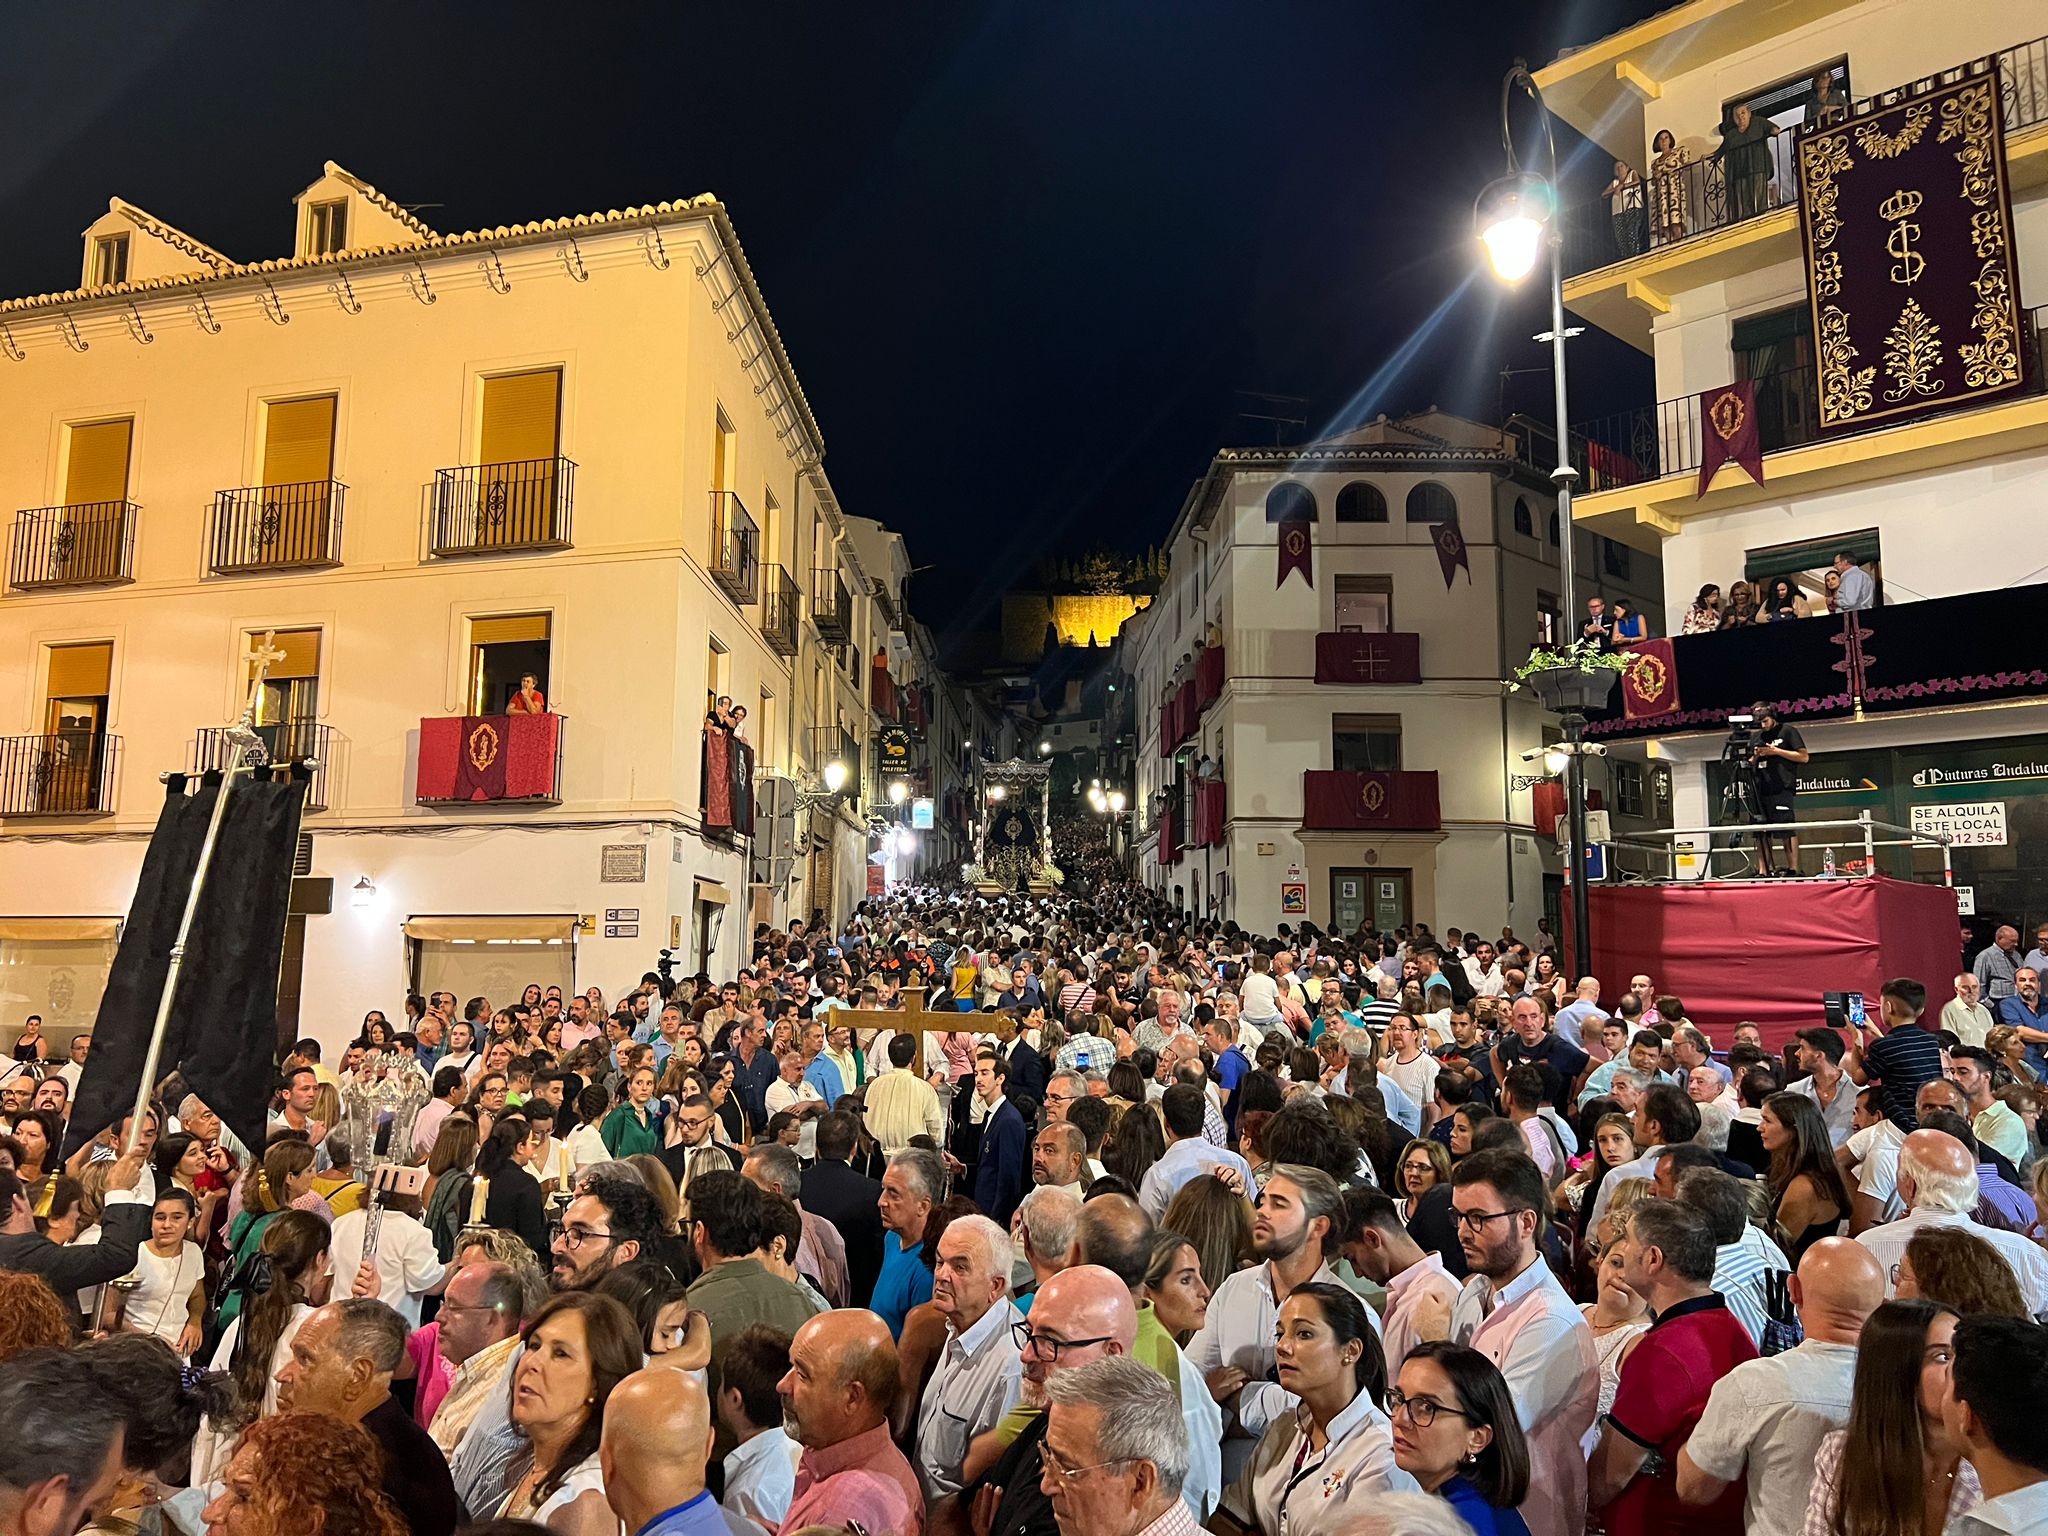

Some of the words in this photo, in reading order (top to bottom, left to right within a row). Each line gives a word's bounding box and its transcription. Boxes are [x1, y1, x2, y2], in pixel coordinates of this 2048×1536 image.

[1928, 768, 1988, 784] Pinturas
[1915, 808, 1932, 819] SE
[1937, 806, 2000, 818] ALQUILA
[1915, 821, 1950, 832] ESTE
[1954, 819, 2002, 830] LOCAL
[1977, 832, 2003, 843] 554
